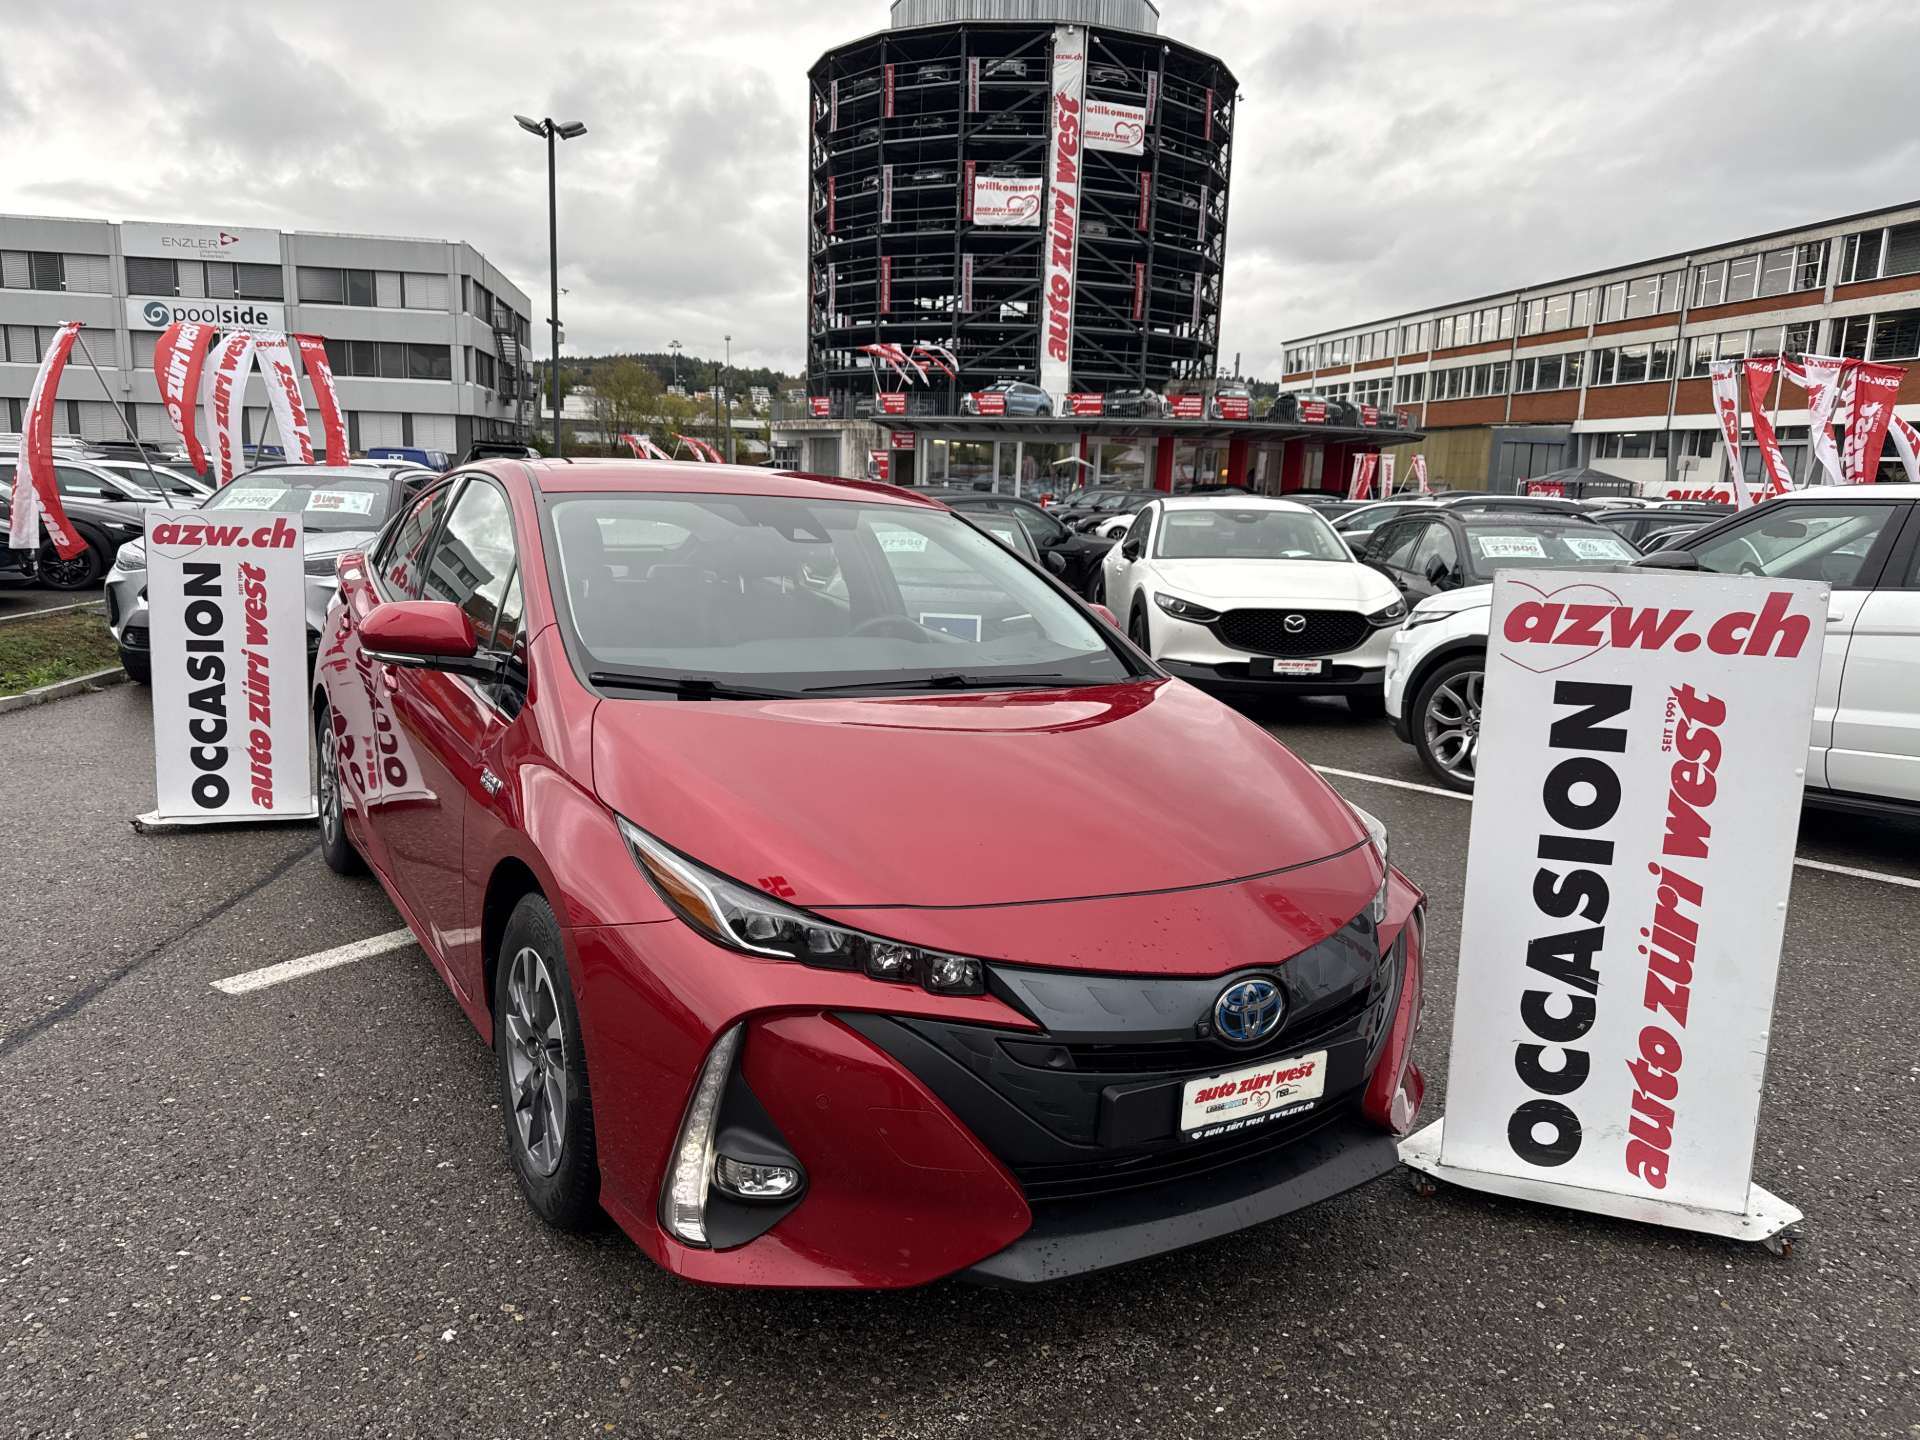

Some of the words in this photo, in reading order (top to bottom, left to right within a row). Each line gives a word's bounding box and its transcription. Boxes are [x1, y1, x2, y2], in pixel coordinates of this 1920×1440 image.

[1056, 92, 1080, 184] west
[1086, 105, 1144, 121] willkommen
[976, 182, 1041, 192] willkommen
[162, 237, 218, 248] ENZLER
[1049, 187, 1076, 274] züri
[173, 304, 269, 326] poolside
[1048, 273, 1072, 362] auto
[164, 347, 191, 402] züri
[212, 371, 233, 431] züri
[272, 361, 307, 427] west
[152, 518, 297, 548] azw.ch
[238, 561, 269, 646] west
[1503, 592, 1811, 659] azw.ch
[183, 562, 229, 809] OCCASION
[241, 648, 272, 728] züri
[1665, 696, 1678, 724] 1991
[244, 729, 274, 810] auto
[1661, 728, 1674, 753] SEIT
[1662, 683, 1728, 860] west
[1507, 680, 1633, 1167] OCCASION
[1637, 862, 1705, 1030] züri
[1195, 1081, 1237, 1105] auto
[1237, 1070, 1275, 1094] züri
[1276, 1062, 1315, 1085] west
[1625, 1025, 1684, 1190] auto
[1204, 1126, 1224, 1138] auto
[1225, 1120, 1245, 1132] züri
[1245, 1115, 1266, 1127] west
[1269, 1101, 1315, 1120] www.azw.ch
